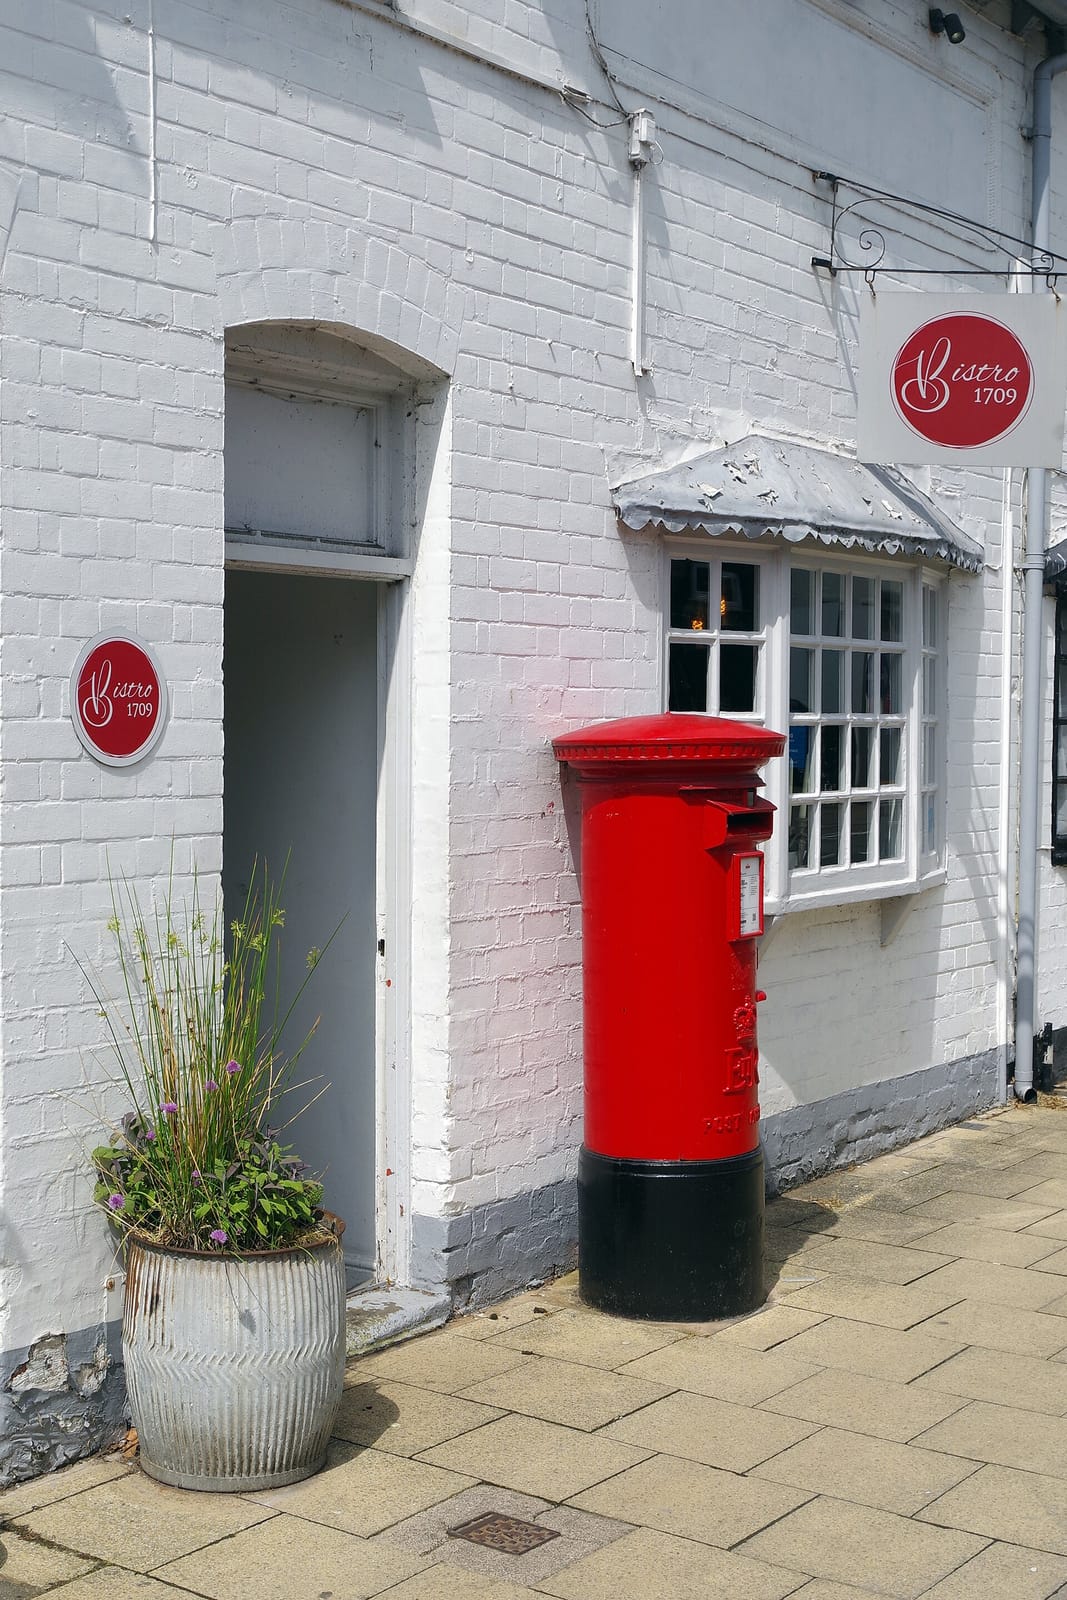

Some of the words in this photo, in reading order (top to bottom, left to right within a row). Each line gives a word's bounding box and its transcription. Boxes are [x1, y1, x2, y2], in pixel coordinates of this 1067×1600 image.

[895, 337, 1020, 413] Bistro
[974, 387, 1018, 406] 1709
[78, 659, 153, 727] Bistro
[127, 702, 153, 718] 1709
